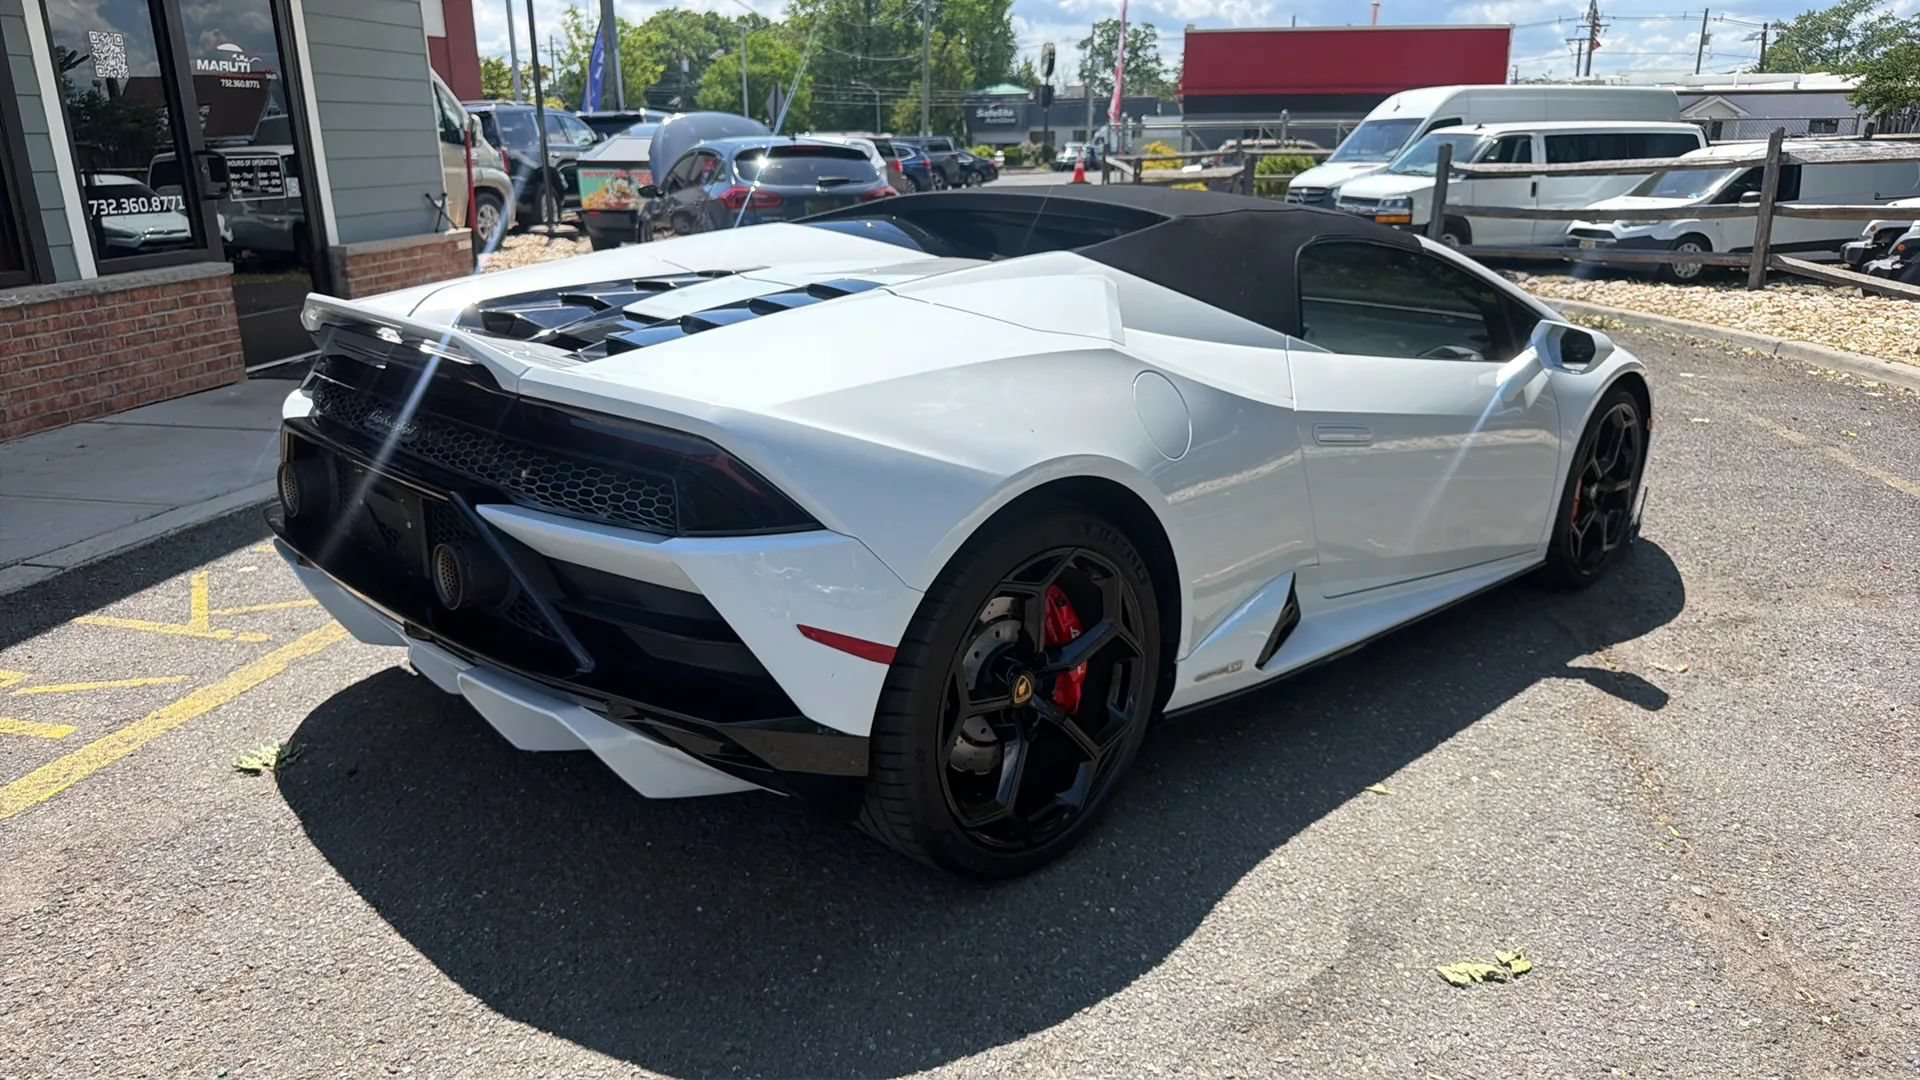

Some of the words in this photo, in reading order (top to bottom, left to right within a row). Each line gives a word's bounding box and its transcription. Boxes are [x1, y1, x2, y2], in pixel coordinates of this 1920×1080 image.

[196, 59, 250, 73] MARUTI
[221, 79, 260, 88] 732.360.8771
[88, 195, 185, 215] 732.360.8771
